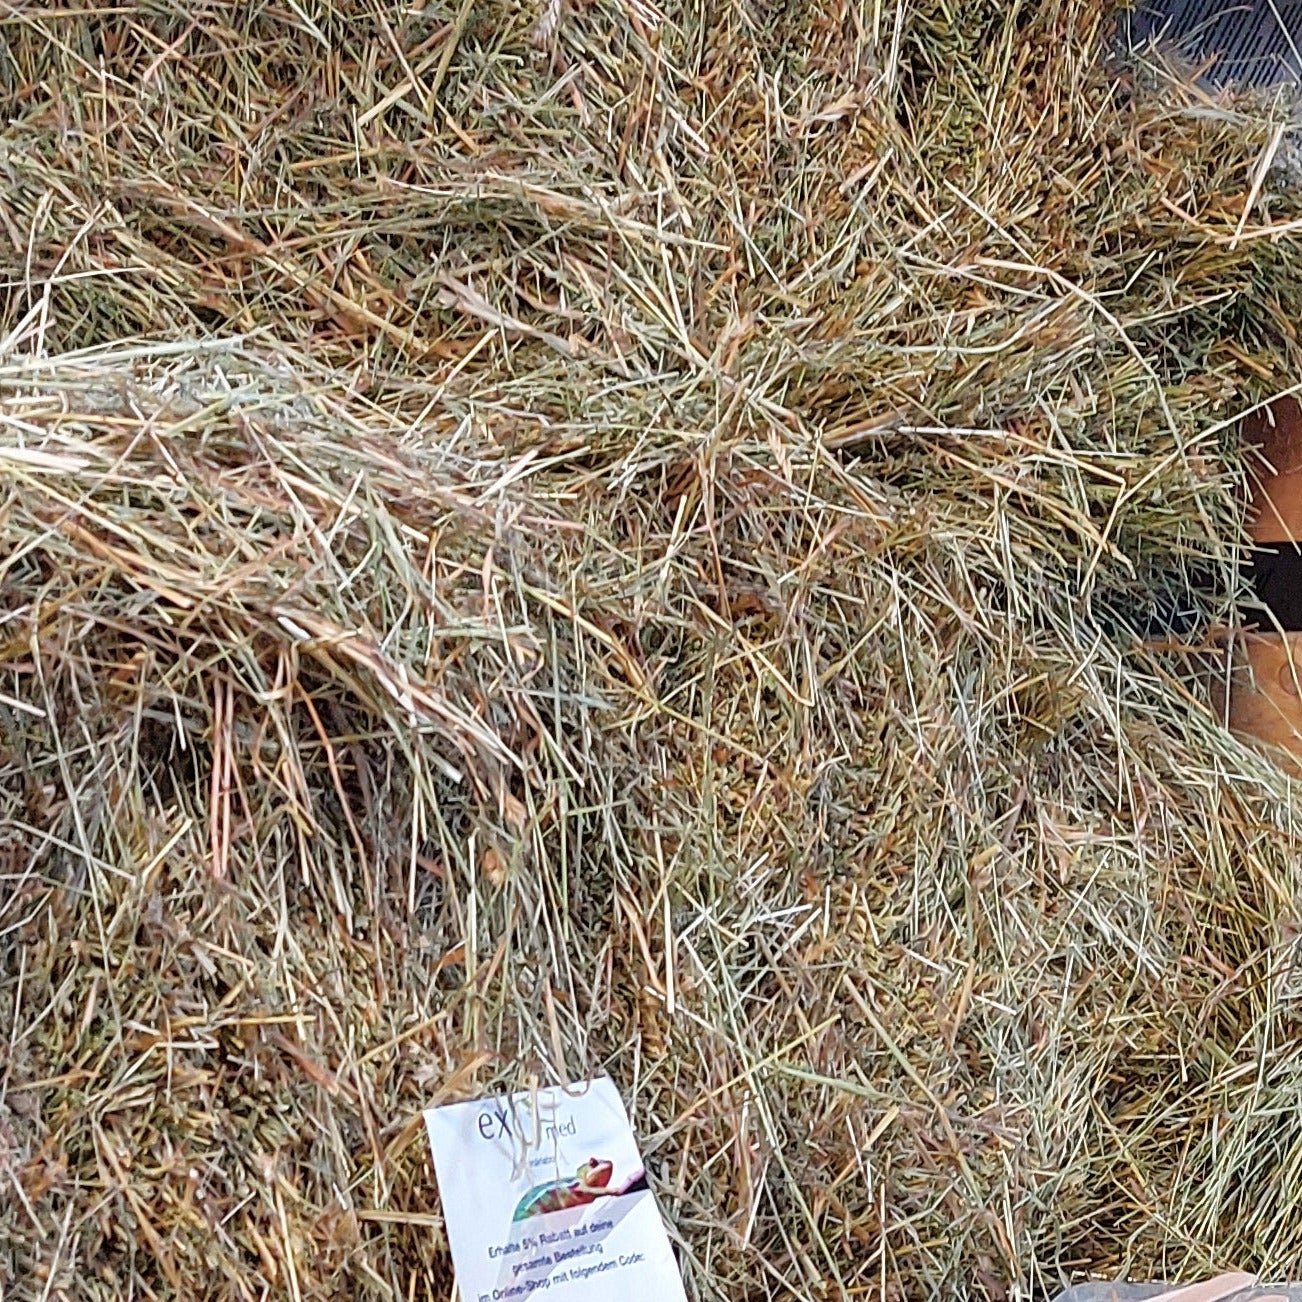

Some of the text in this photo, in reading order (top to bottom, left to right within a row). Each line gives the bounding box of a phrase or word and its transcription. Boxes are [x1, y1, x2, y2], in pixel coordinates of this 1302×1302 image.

[487, 1242, 520, 1258] Erhalte
[539, 1230, 572, 1246] Rabatt
[574, 1224, 589, 1238] auf
[590, 1219, 614, 1233] deine
[492, 1276, 551, 1300] Online-Shop
[552, 1272, 569, 1286] mit
[569, 1259, 619, 1280] folgendem
[512, 1243, 604, 1277] gesamte Bestellung
